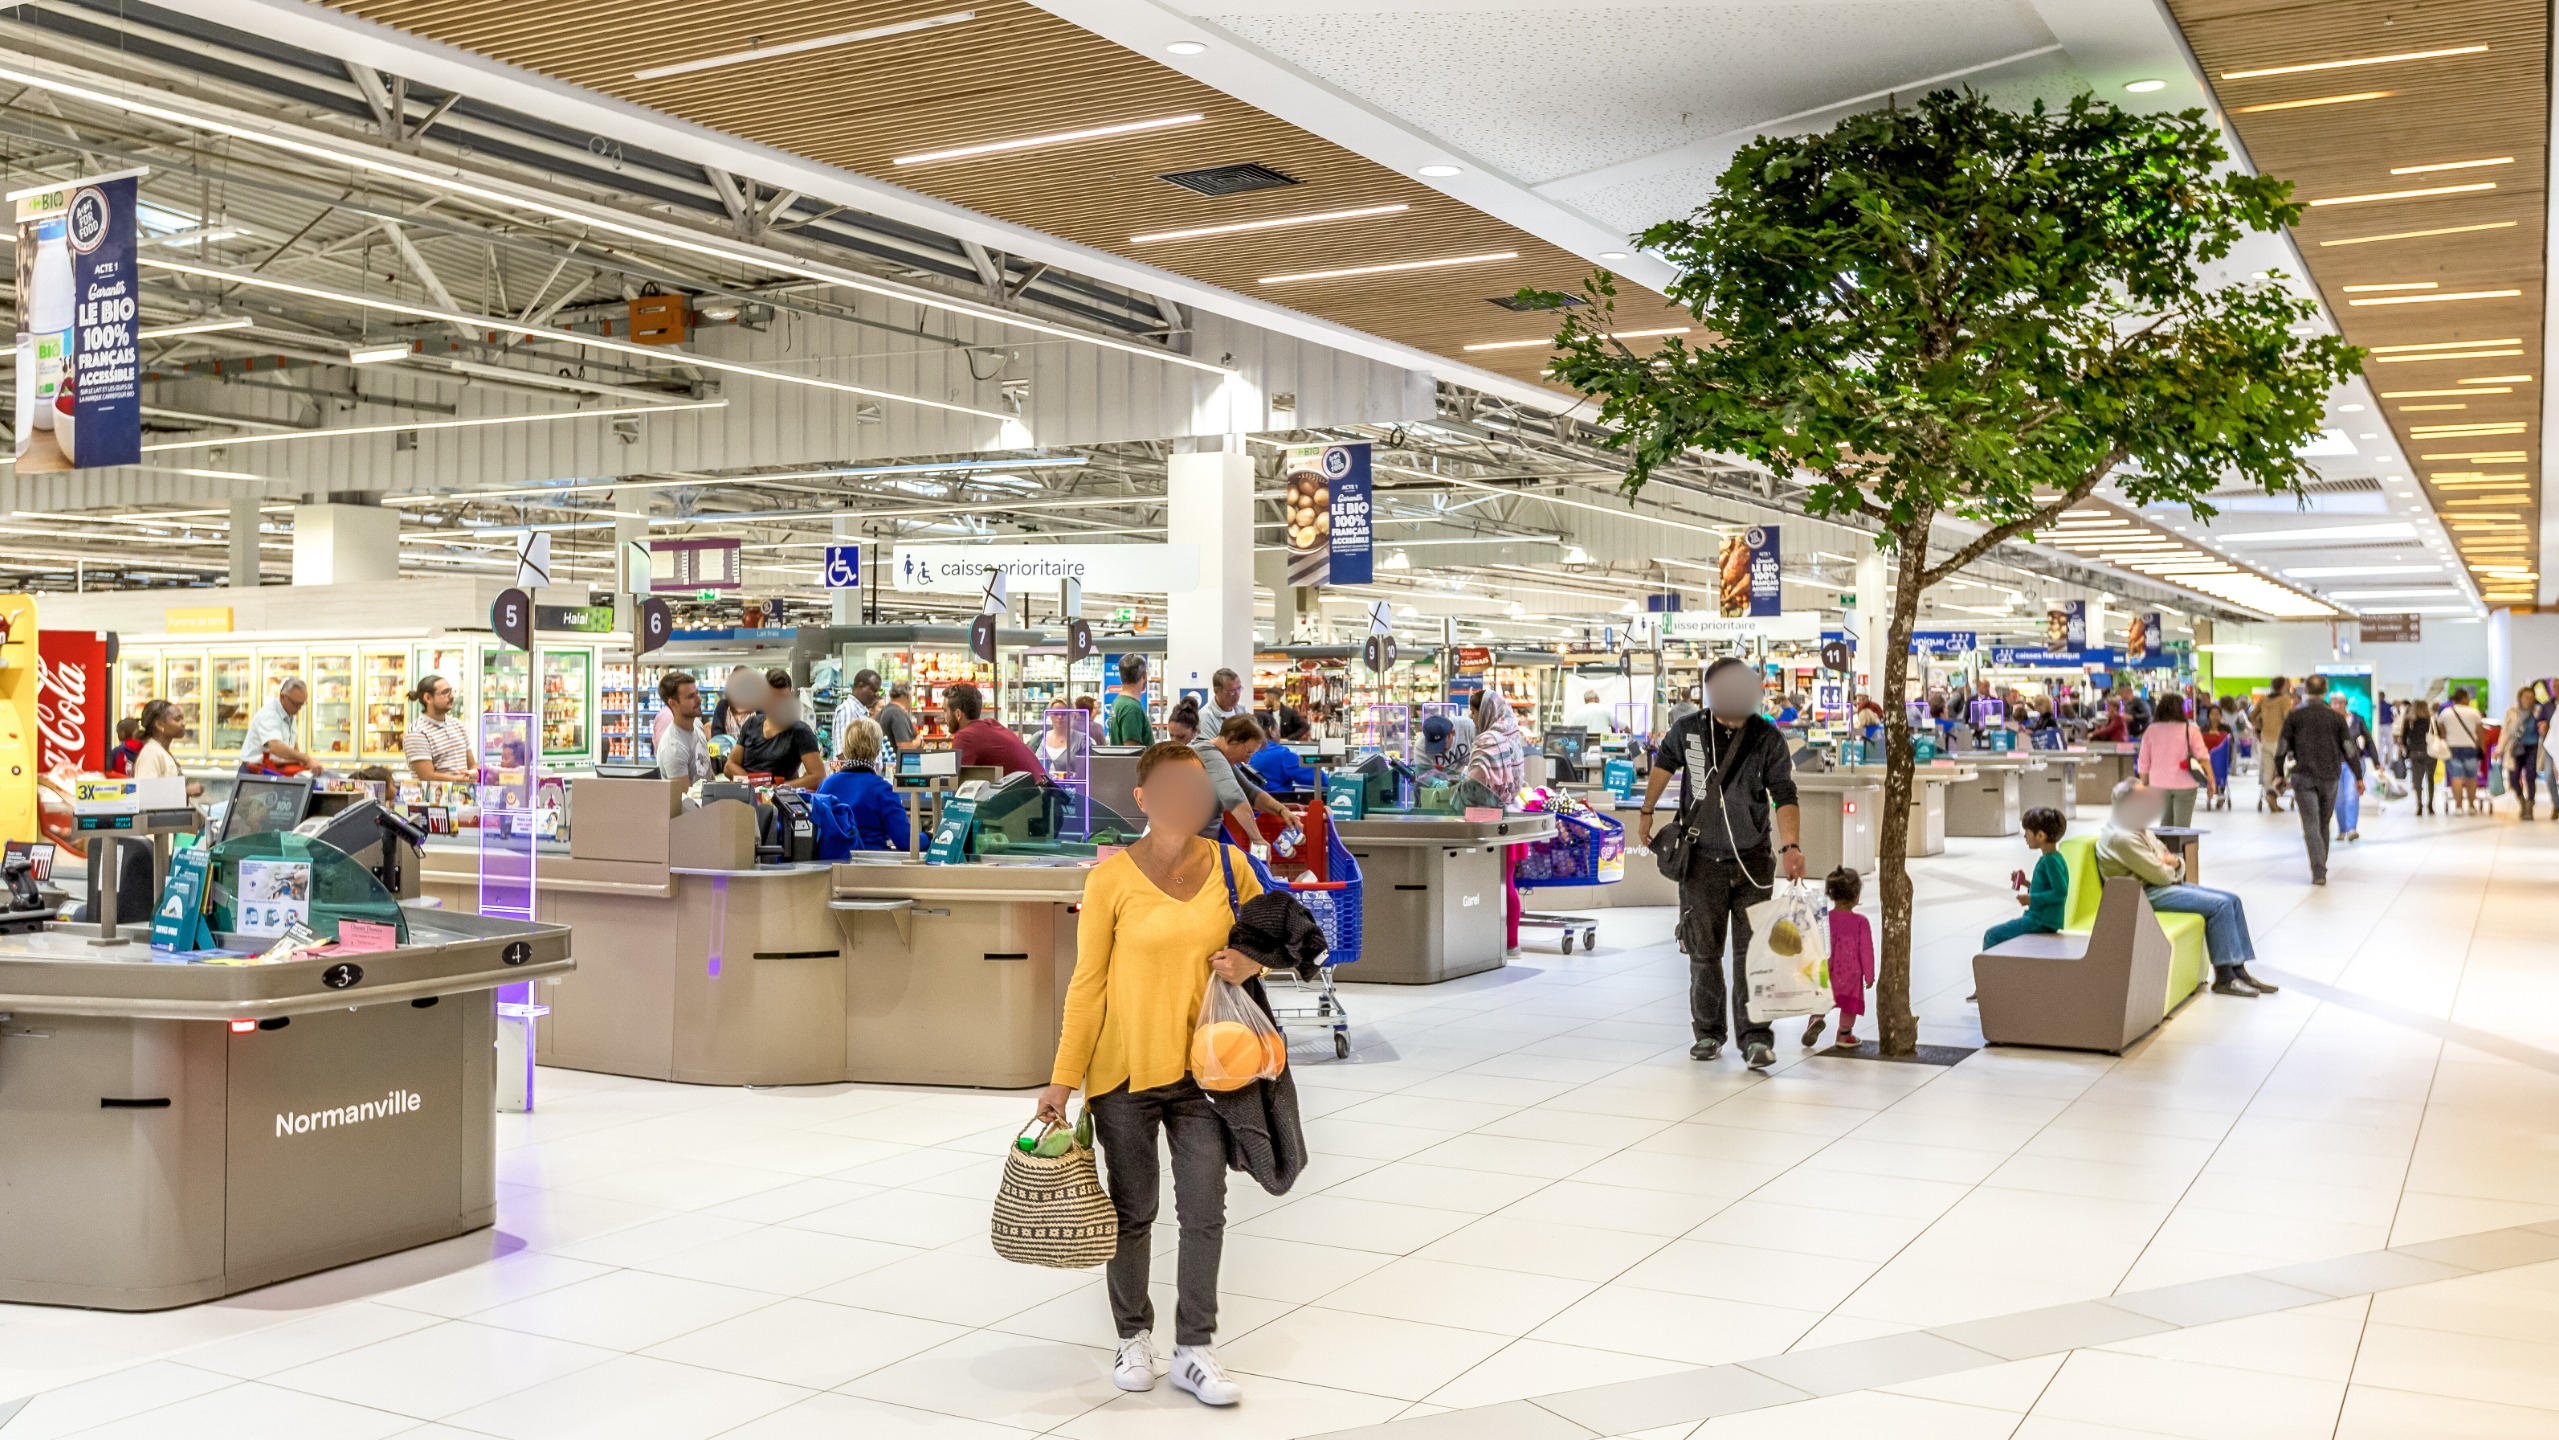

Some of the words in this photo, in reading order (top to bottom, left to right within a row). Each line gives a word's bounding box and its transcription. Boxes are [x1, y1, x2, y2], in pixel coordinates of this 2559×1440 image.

[42, 191, 64, 211] BIO
[79, 211, 94, 229] FOR
[79, 220, 99, 240] FOOD
[94, 262, 114, 275] ACTE
[114, 261, 119, 271] 1
[79, 301, 98, 327] LE
[101, 296, 136, 322] BIO
[83, 323, 130, 352] 100%
[79, 347, 136, 370] FRANÇAIS
[79, 367, 135, 387] ACCESSIBLE
[1331, 503, 1345, 516] LE
[1346, 502, 1370, 515] BIO
[1334, 515, 1366, 527] 100%
[1331, 526, 1370, 538] FRANÇAIS
[1332, 536, 1370, 545] ACCESSIBLE
[998, 559, 1085, 576] prioritaire
[505, 604, 518, 628] 5
[563, 612, 589, 625] Halal
[650, 612, 662, 634] 6
[1674, 620, 1699, 630] isse
[1700, 619, 1756, 631] prioritaire
[978, 628, 987, 646] 7
[1078, 631, 1086, 648] 8
[1911, 635, 1945, 648] unique
[1368, 644, 1375, 660] 9
[1387, 643, 1396, 659] 10
[1826, 649, 1840, 663] 11
[78, 784, 95, 800] 3X
[511, 943, 521, 964] 4
[337, 965, 349, 987] 3
[275, 1089, 422, 1138] Normanville
